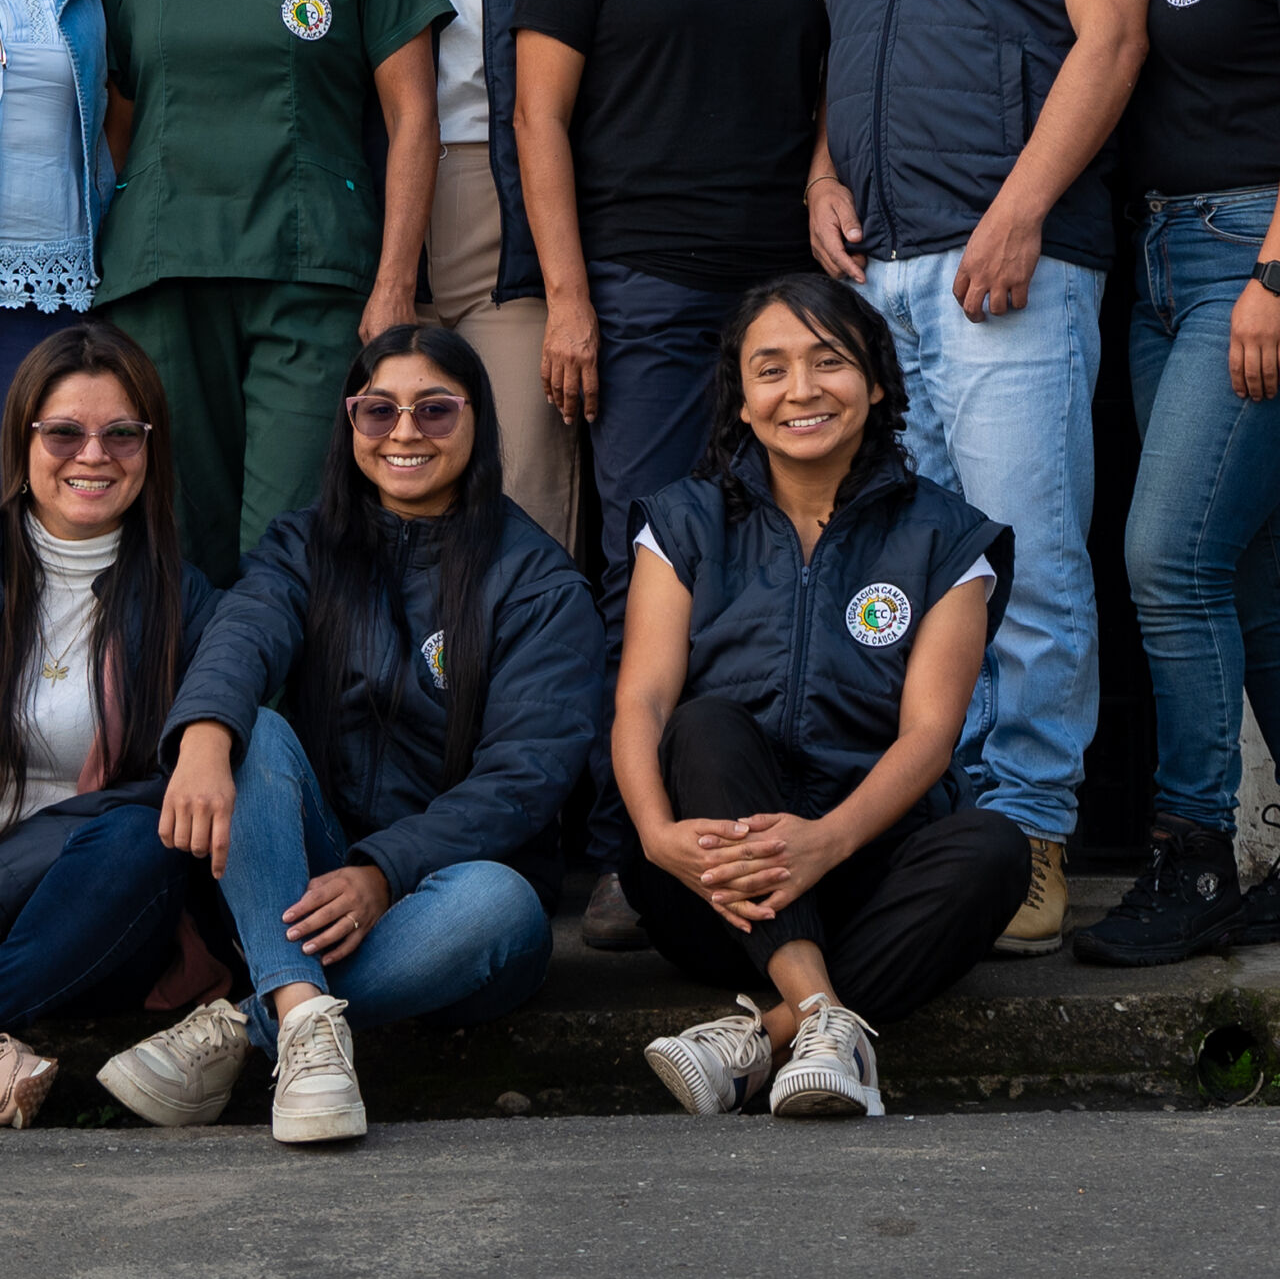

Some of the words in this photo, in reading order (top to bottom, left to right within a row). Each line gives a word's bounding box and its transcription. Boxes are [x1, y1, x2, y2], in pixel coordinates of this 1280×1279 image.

[881, 586, 908, 625] CAMPESINA
[867, 609, 887, 619] FCC
[855, 630, 869, 643] DEL
[872, 631, 899, 644] CAUCA
